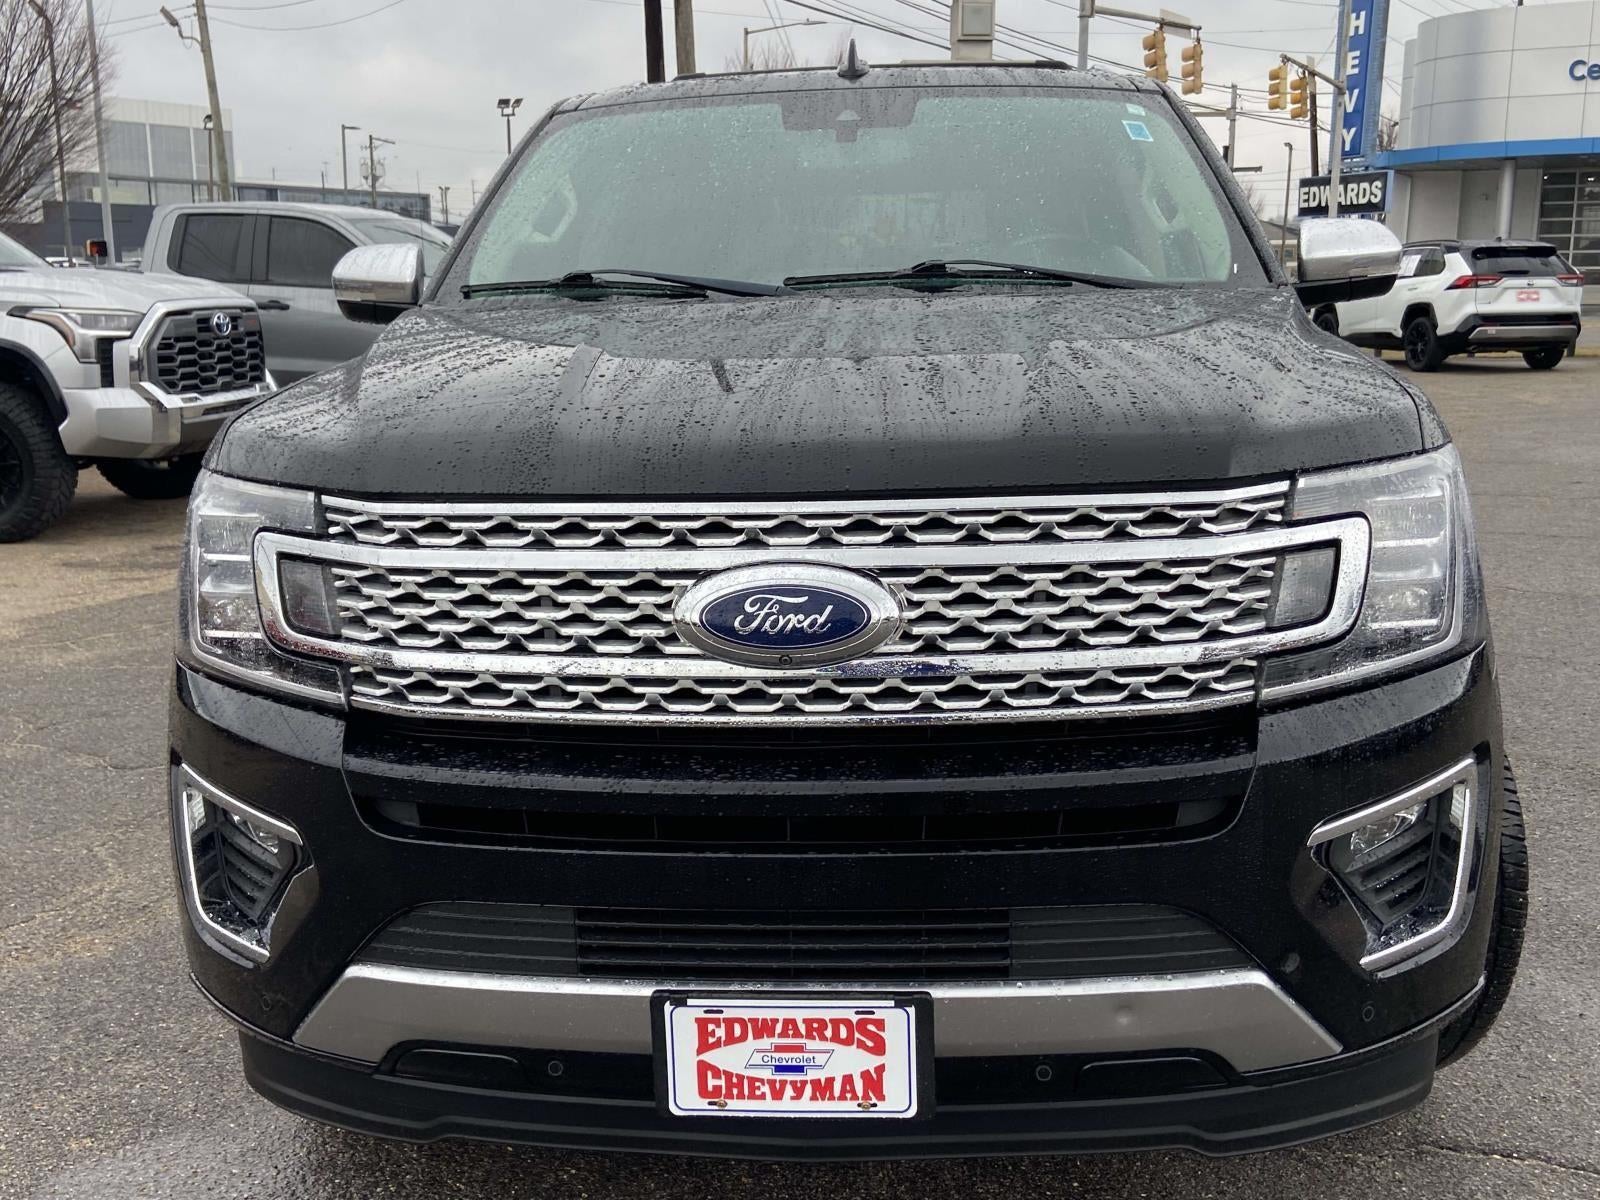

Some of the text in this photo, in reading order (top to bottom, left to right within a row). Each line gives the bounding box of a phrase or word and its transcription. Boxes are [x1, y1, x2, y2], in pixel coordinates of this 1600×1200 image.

[1300, 181, 1382, 208] EDWARDS
[733, 594, 833, 634] Ford
[695, 1017, 886, 1056] EDWARDS
[761, 1054, 816, 1065] Chevrolet
[696, 1059, 886, 1102] CHEVYMAN
